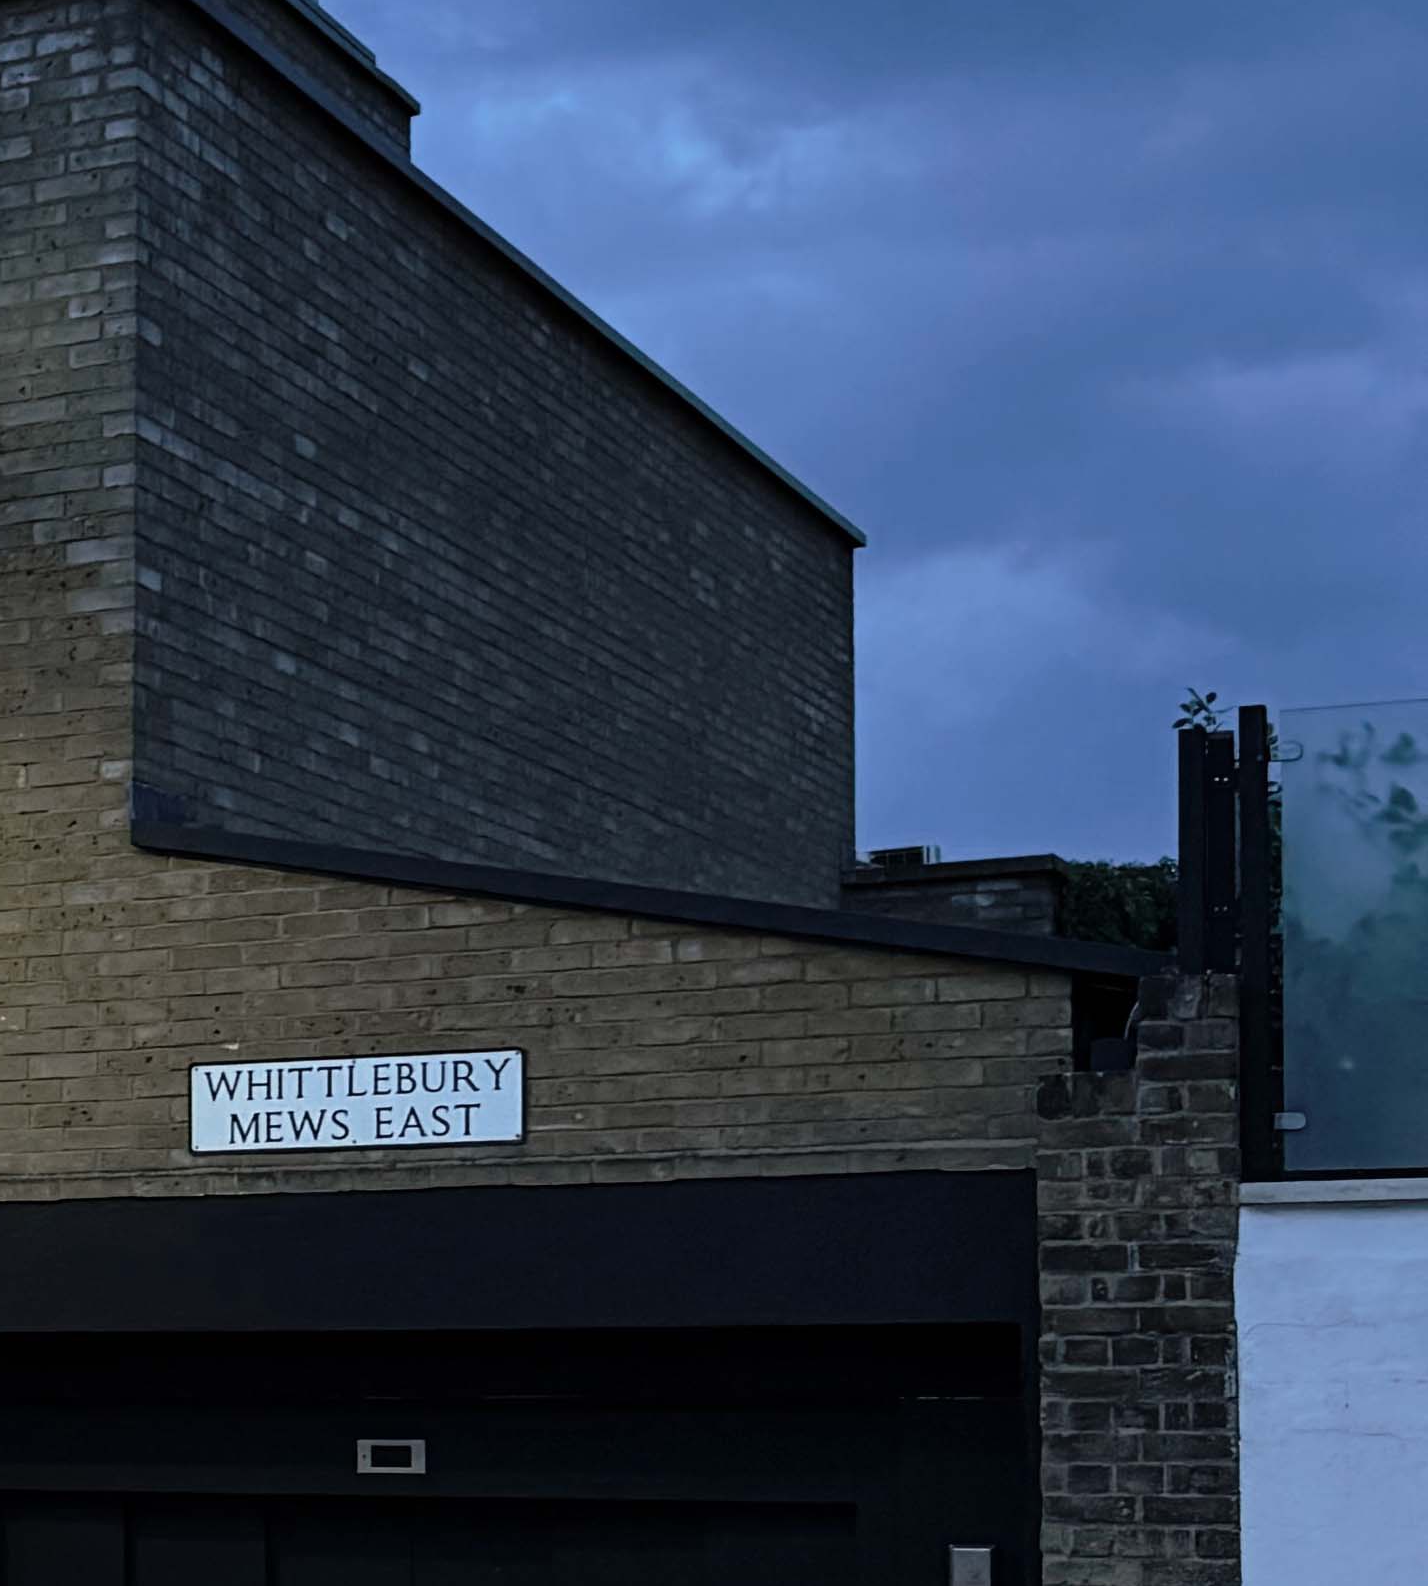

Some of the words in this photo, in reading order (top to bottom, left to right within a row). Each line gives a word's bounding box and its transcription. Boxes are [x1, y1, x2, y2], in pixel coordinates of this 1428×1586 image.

[204, 1057, 512, 1102] WHITTLEBURY
[228, 1108, 351, 1145] MEWS
[374, 1103, 482, 1139] EAST
